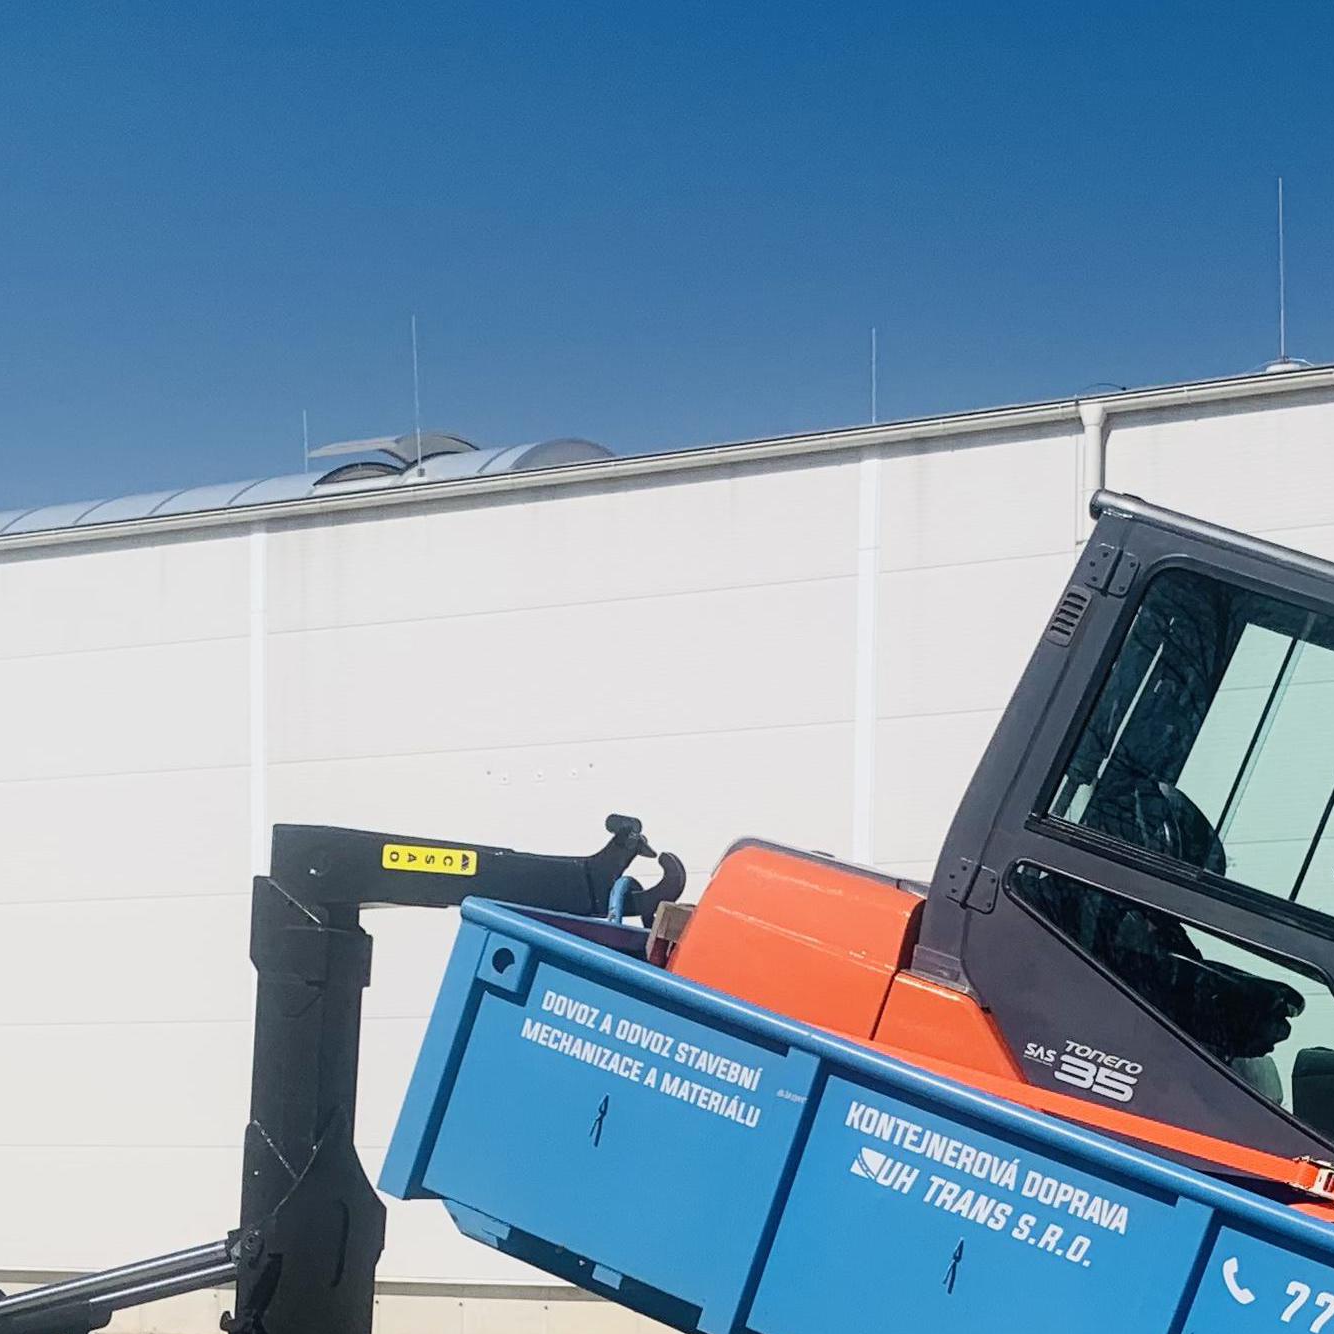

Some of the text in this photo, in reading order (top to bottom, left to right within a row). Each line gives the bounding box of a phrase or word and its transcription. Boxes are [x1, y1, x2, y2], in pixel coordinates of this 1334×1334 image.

[521, 1018, 762, 1129] MECHANIZACE A MATERIÁLU
[541, 989, 764, 1092] DOVOZ A ODVOZ STAVEBNÍ
[1024, 1042, 1057, 1062] SAS
[1054, 1053, 1138, 1102] 35
[845, 1100, 1128, 1235] KONTEJNEROVÁ DOPRAVA
[875, 1157, 1092, 1268] UH TRANS S.R.O.
